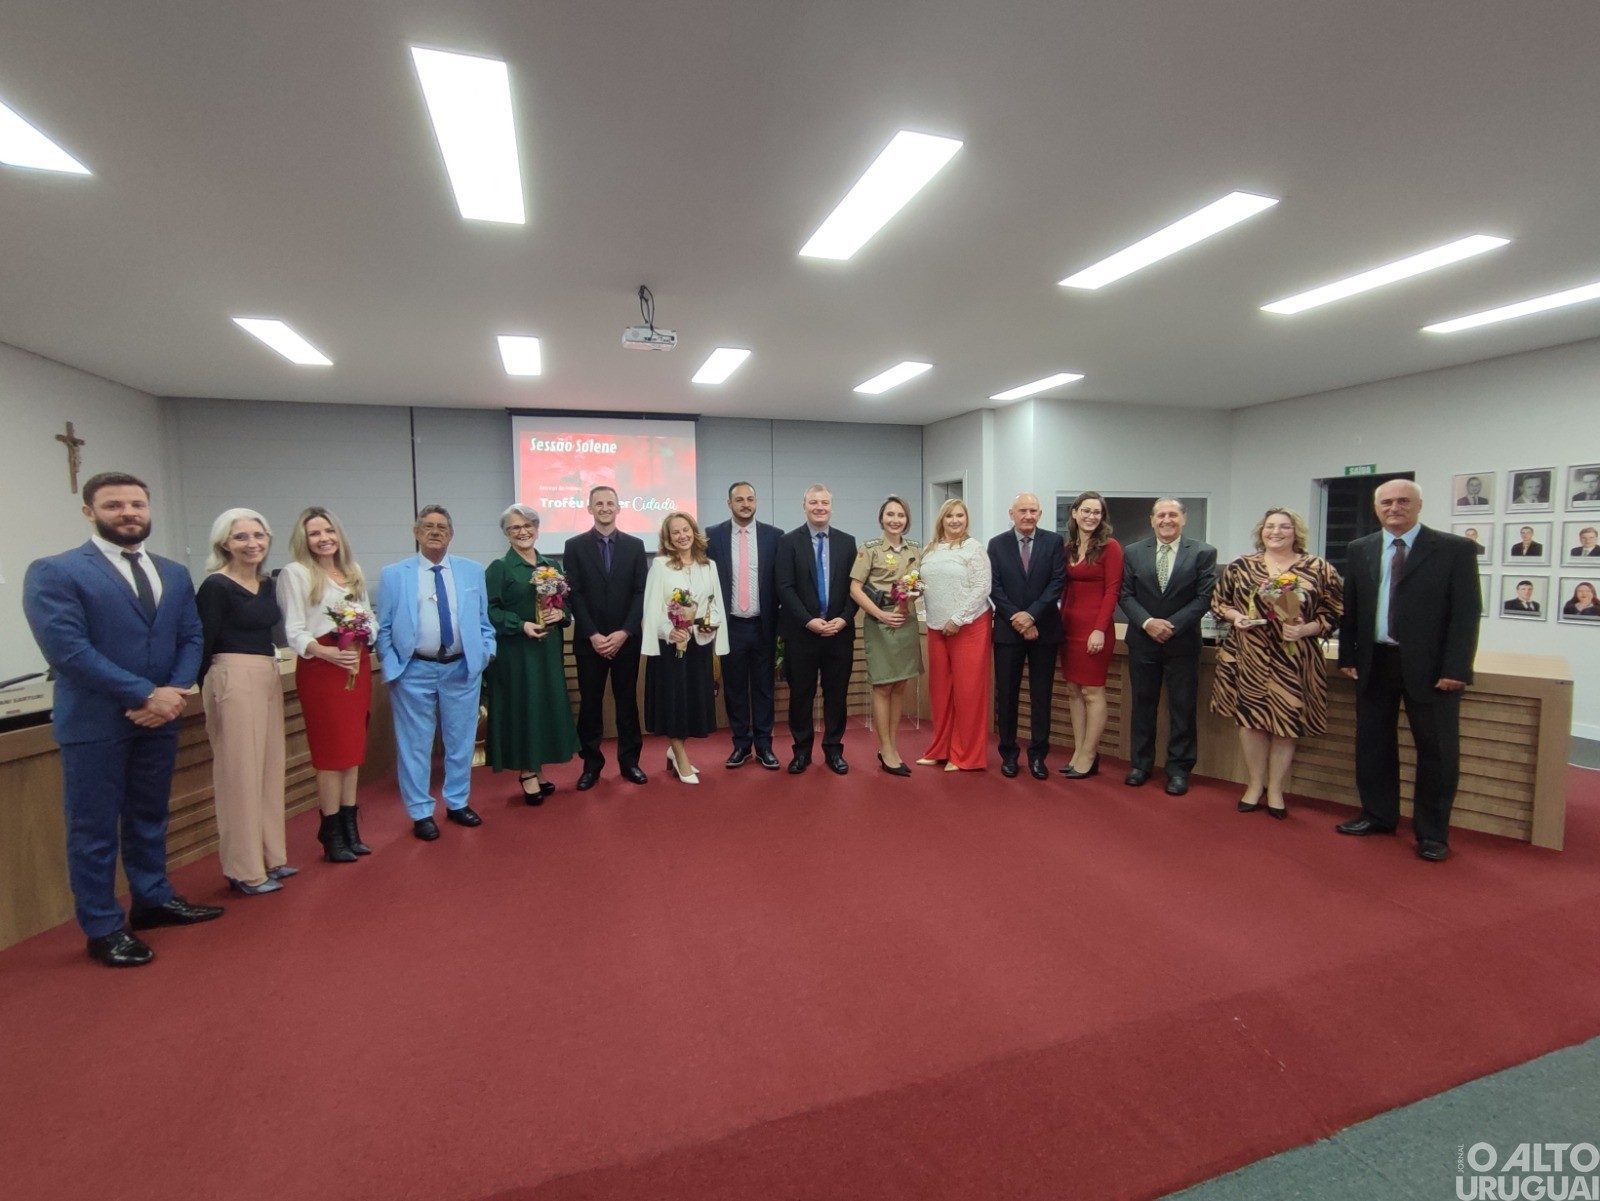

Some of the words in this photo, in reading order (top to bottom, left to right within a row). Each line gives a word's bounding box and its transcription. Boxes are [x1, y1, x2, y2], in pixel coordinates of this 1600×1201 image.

[530, 437, 573, 452] Sessão
[575, 439, 618, 453] Solene
[541, 497, 584, 508] Troféu
